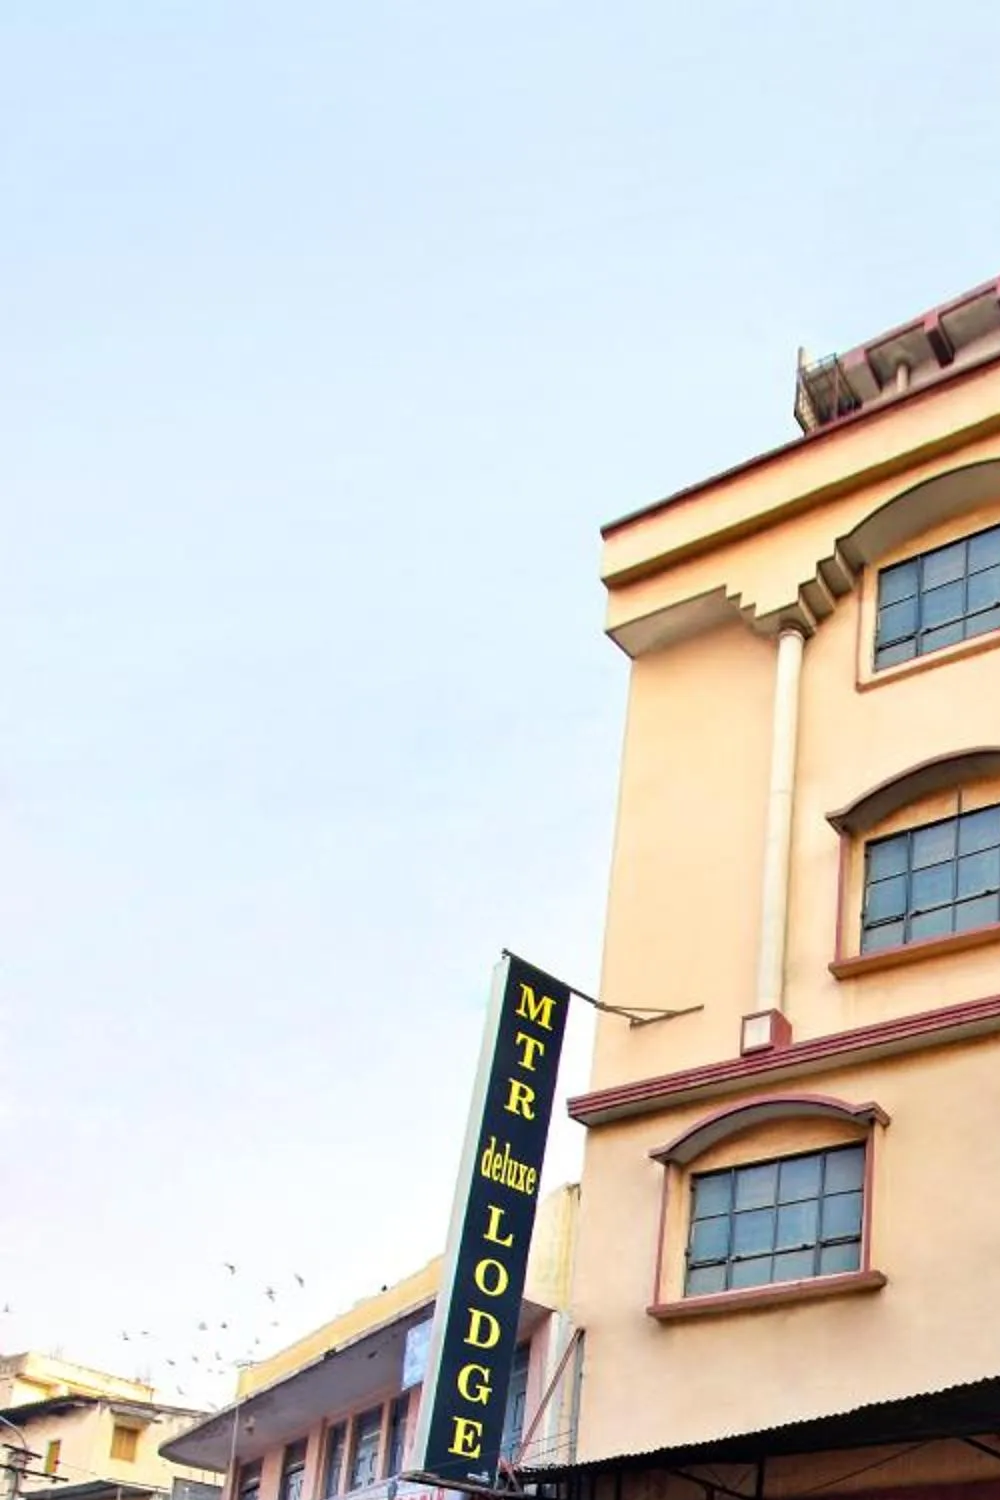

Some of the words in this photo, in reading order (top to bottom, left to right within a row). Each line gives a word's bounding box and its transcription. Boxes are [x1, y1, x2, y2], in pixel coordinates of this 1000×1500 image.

[503, 982, 557, 1121] MTR
[481, 1135, 537, 1196] deluxe
[448, 1204, 514, 1460] LODGE
